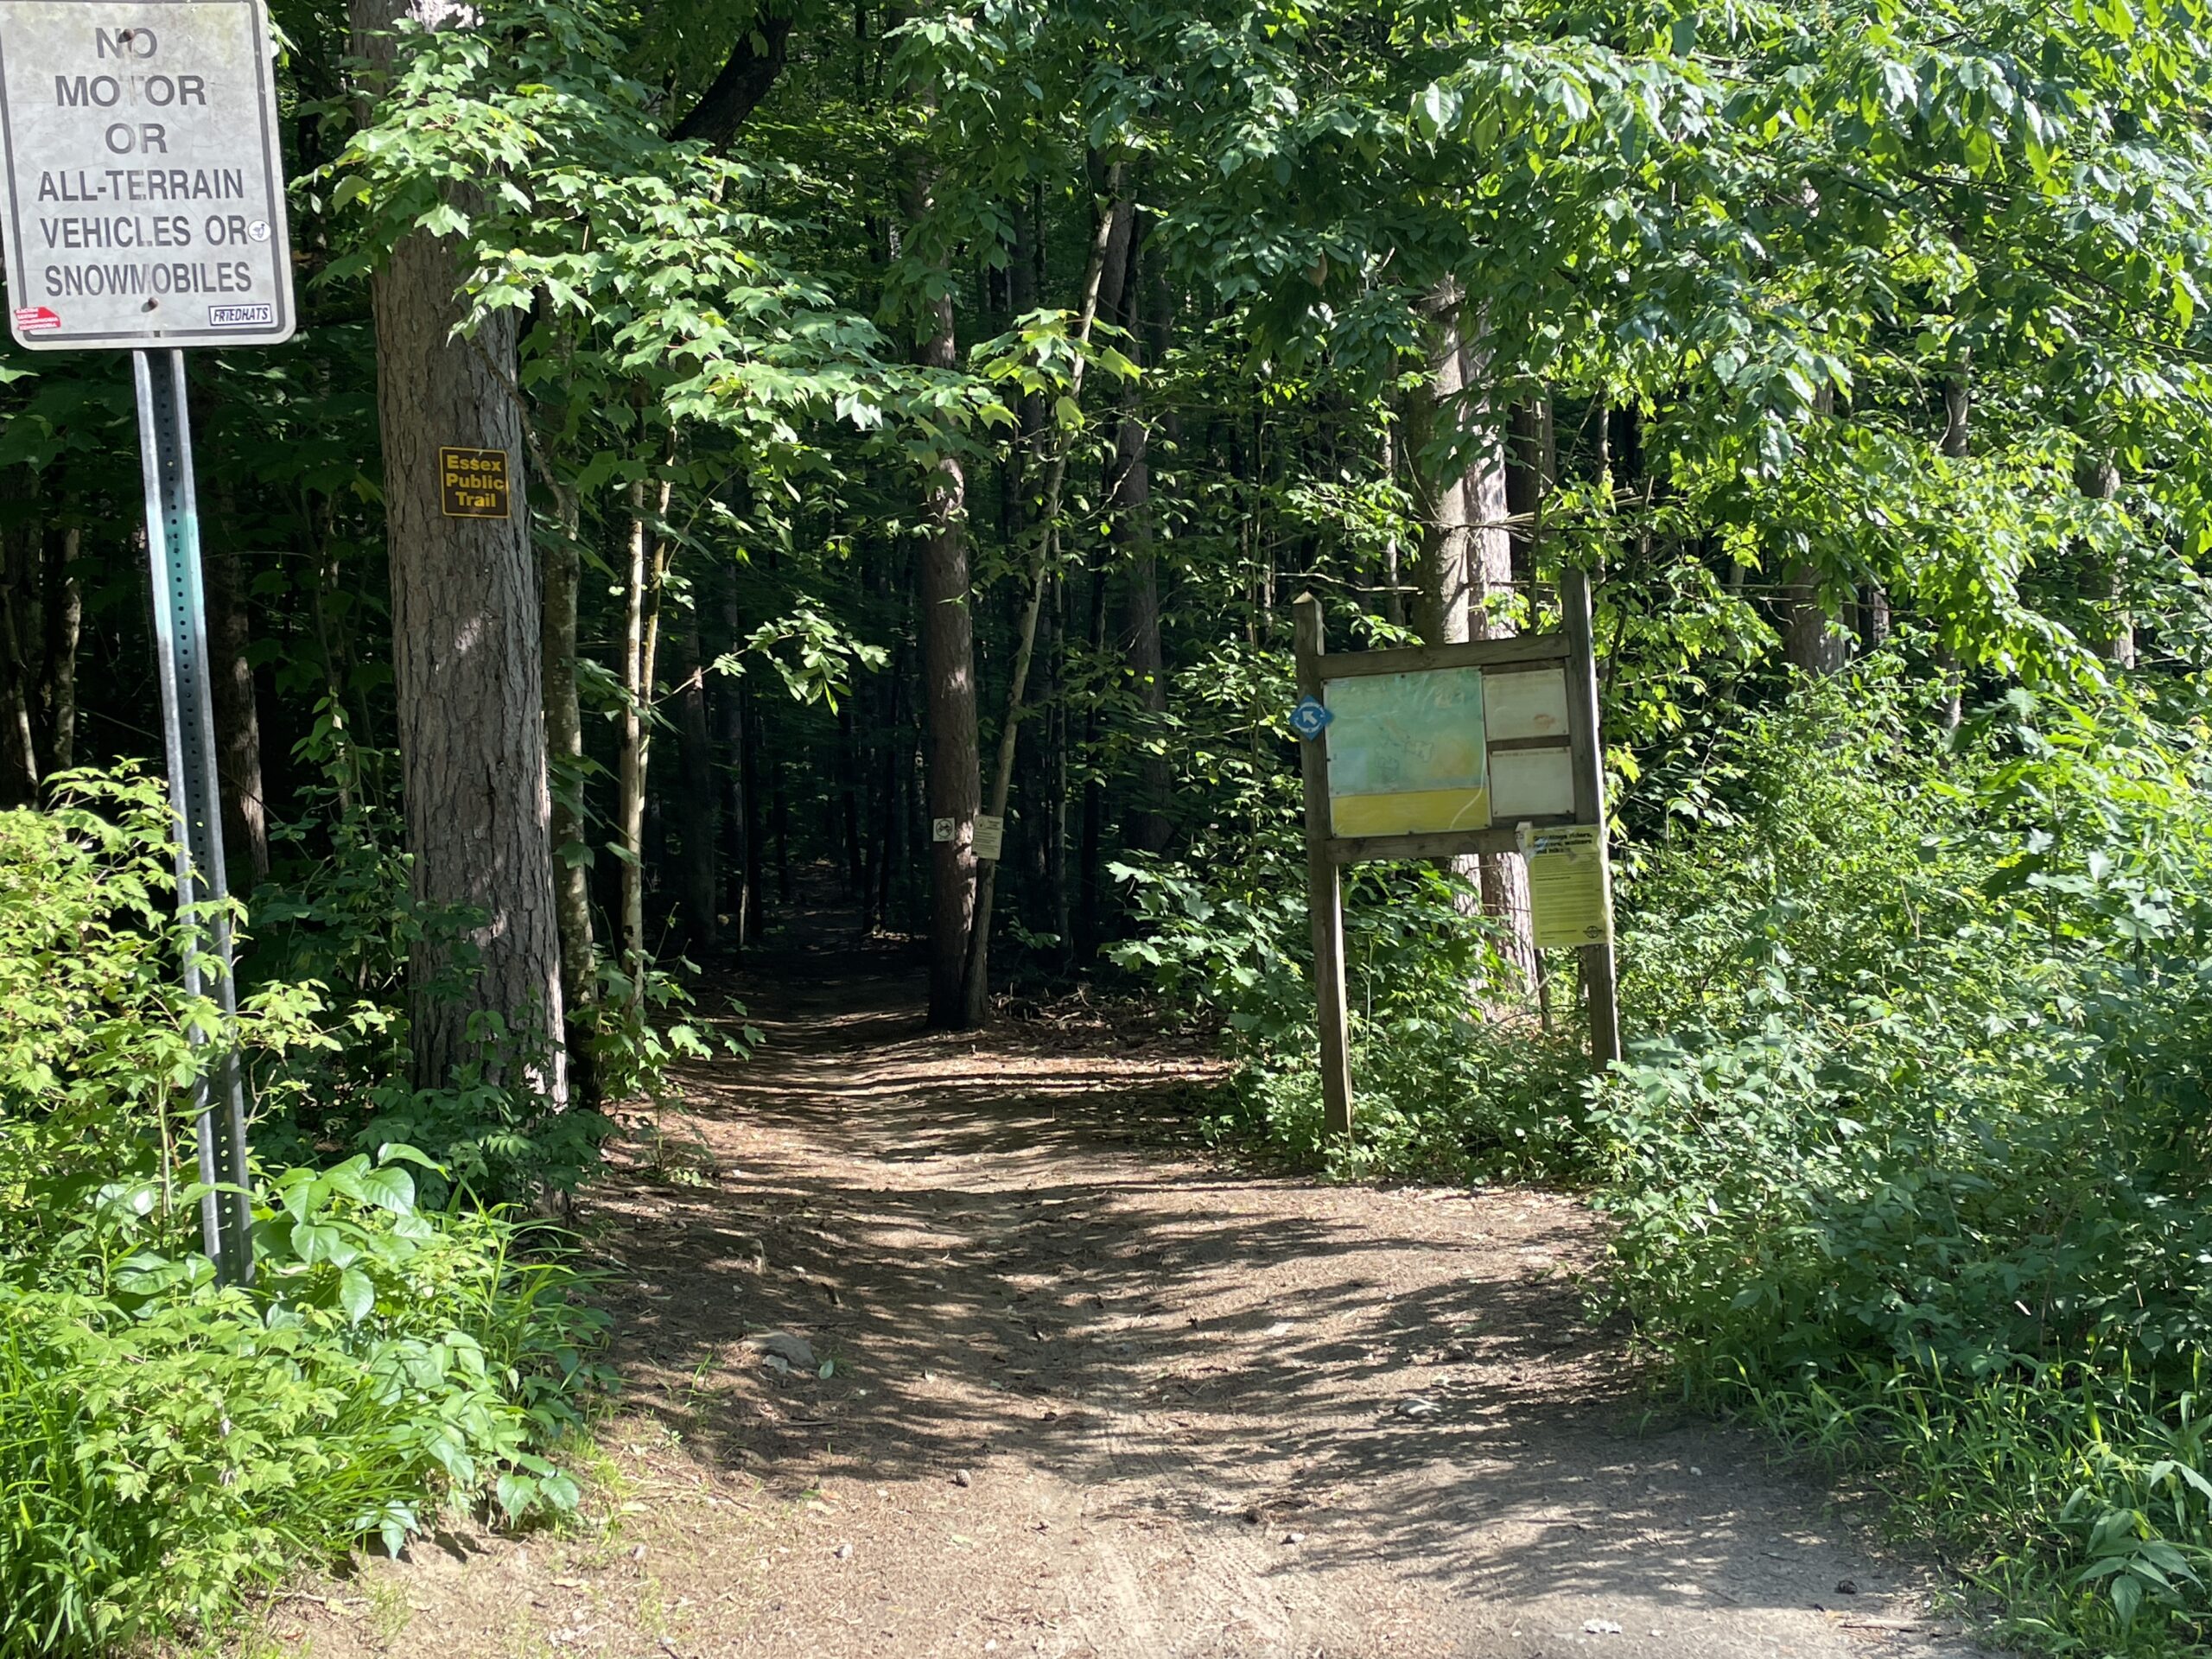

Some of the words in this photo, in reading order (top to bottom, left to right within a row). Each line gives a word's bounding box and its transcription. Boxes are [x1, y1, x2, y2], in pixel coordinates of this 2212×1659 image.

[95, 27, 157, 59] NO
[55, 75, 207, 107] MOTOR
[106, 124, 168, 154] OR
[38, 169, 244, 201] ALL-TERRAIN
[40, 216, 191, 248] VEHICLES
[205, 215, 247, 245] OR
[45, 262, 251, 296] SNOWMOBILES
[213, 307, 269, 322] FRIEDHATS
[446, 454, 502, 472] Essex
[446, 473, 505, 490] Public
[454, 491, 496, 507] Trail
